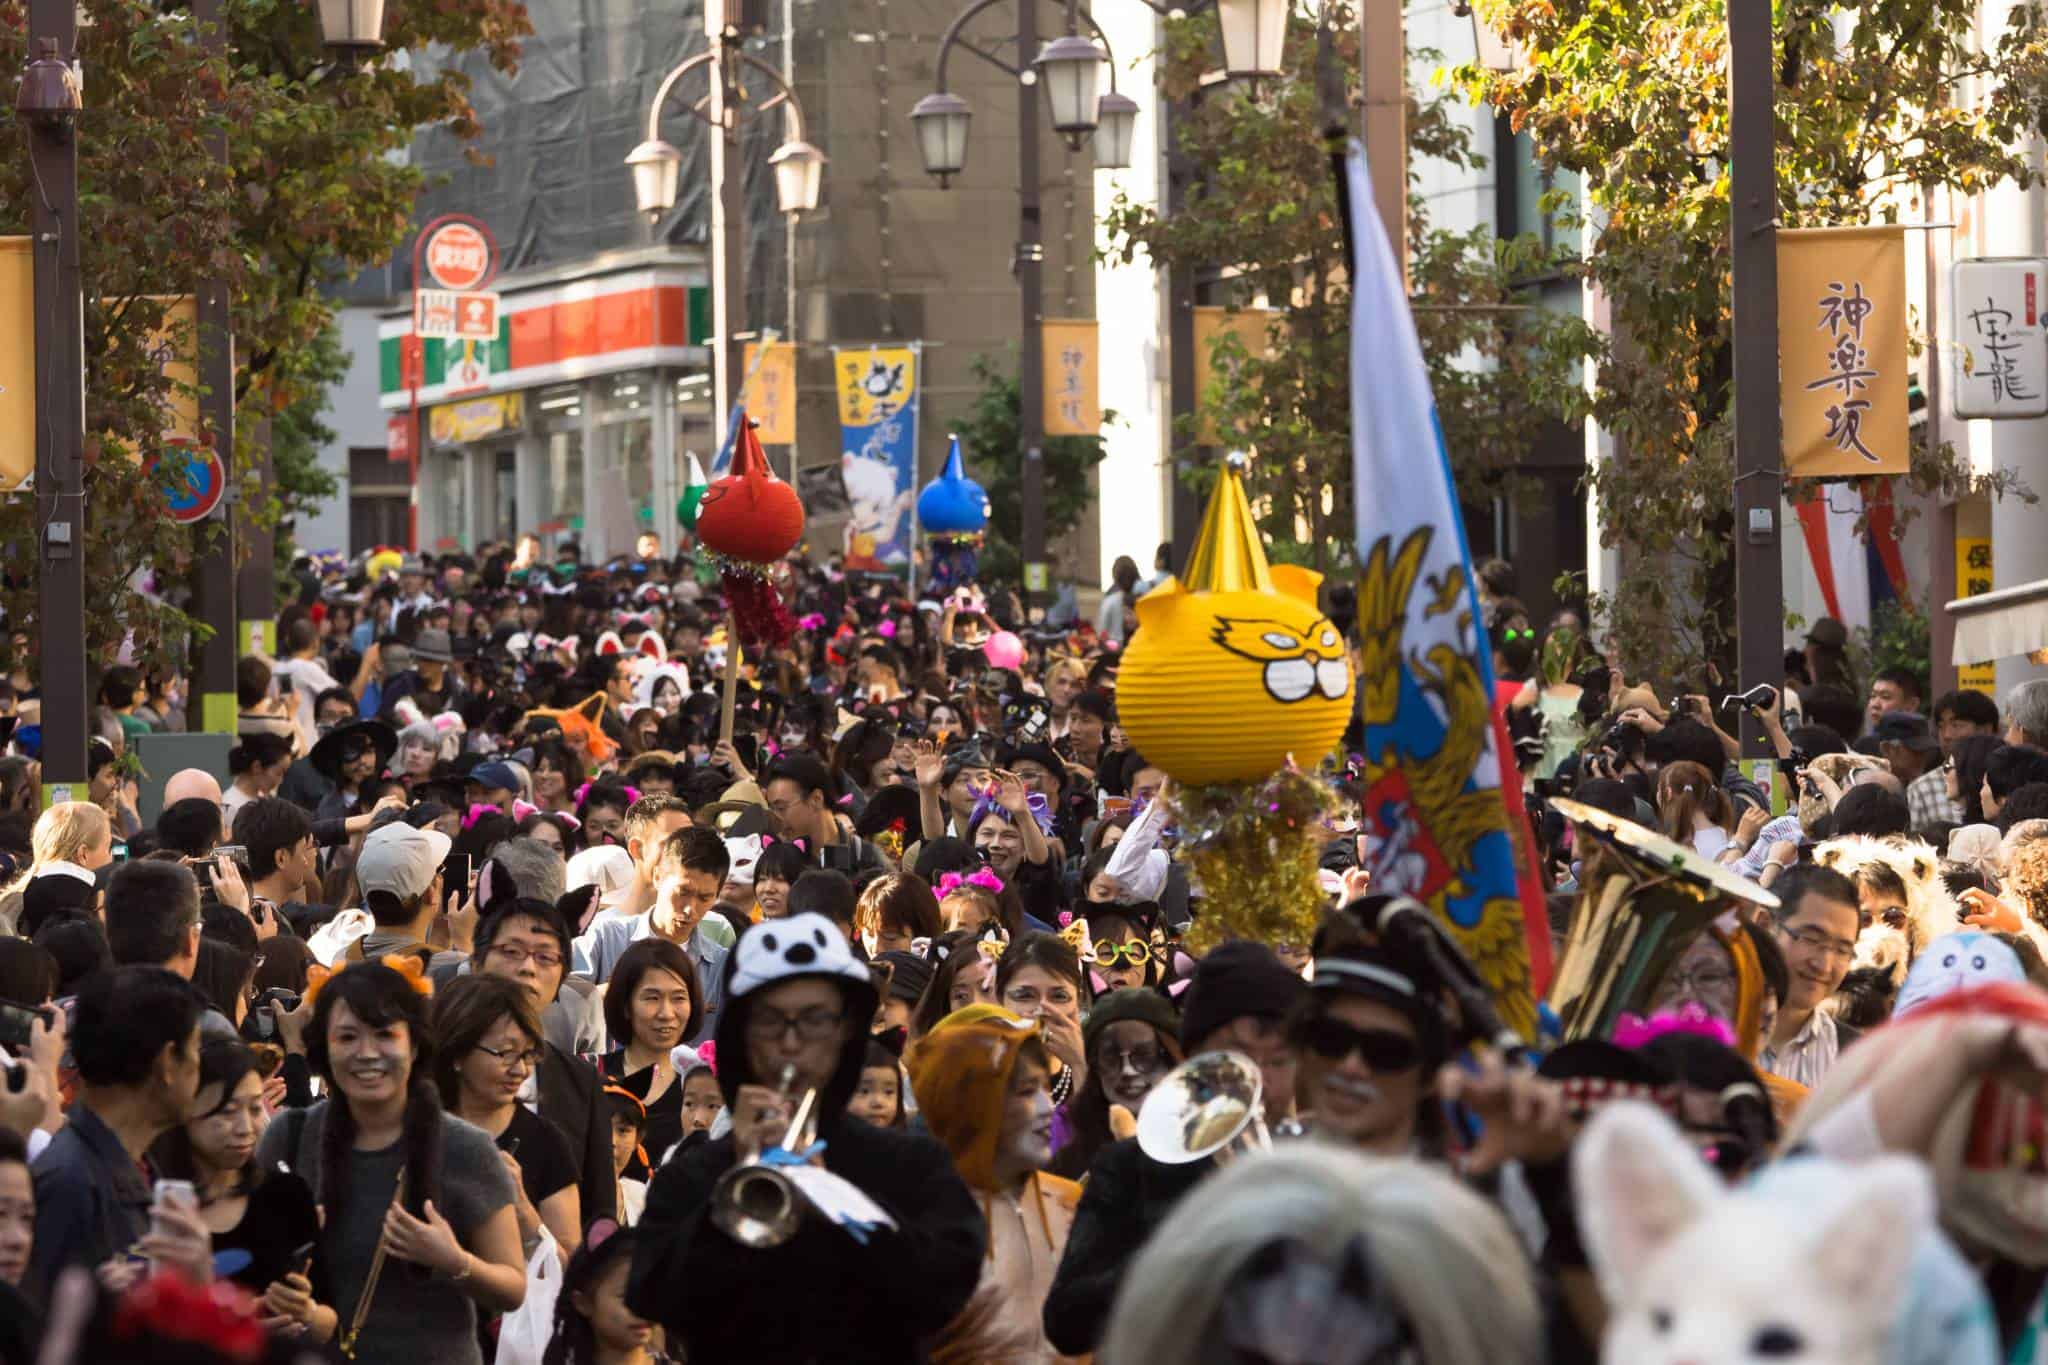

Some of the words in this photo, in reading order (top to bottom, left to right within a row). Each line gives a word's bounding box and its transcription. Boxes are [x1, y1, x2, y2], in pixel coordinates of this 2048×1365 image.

[1805, 282, 1880, 464] 神楽坂
[1967, 296, 2040, 404] 宝龍
